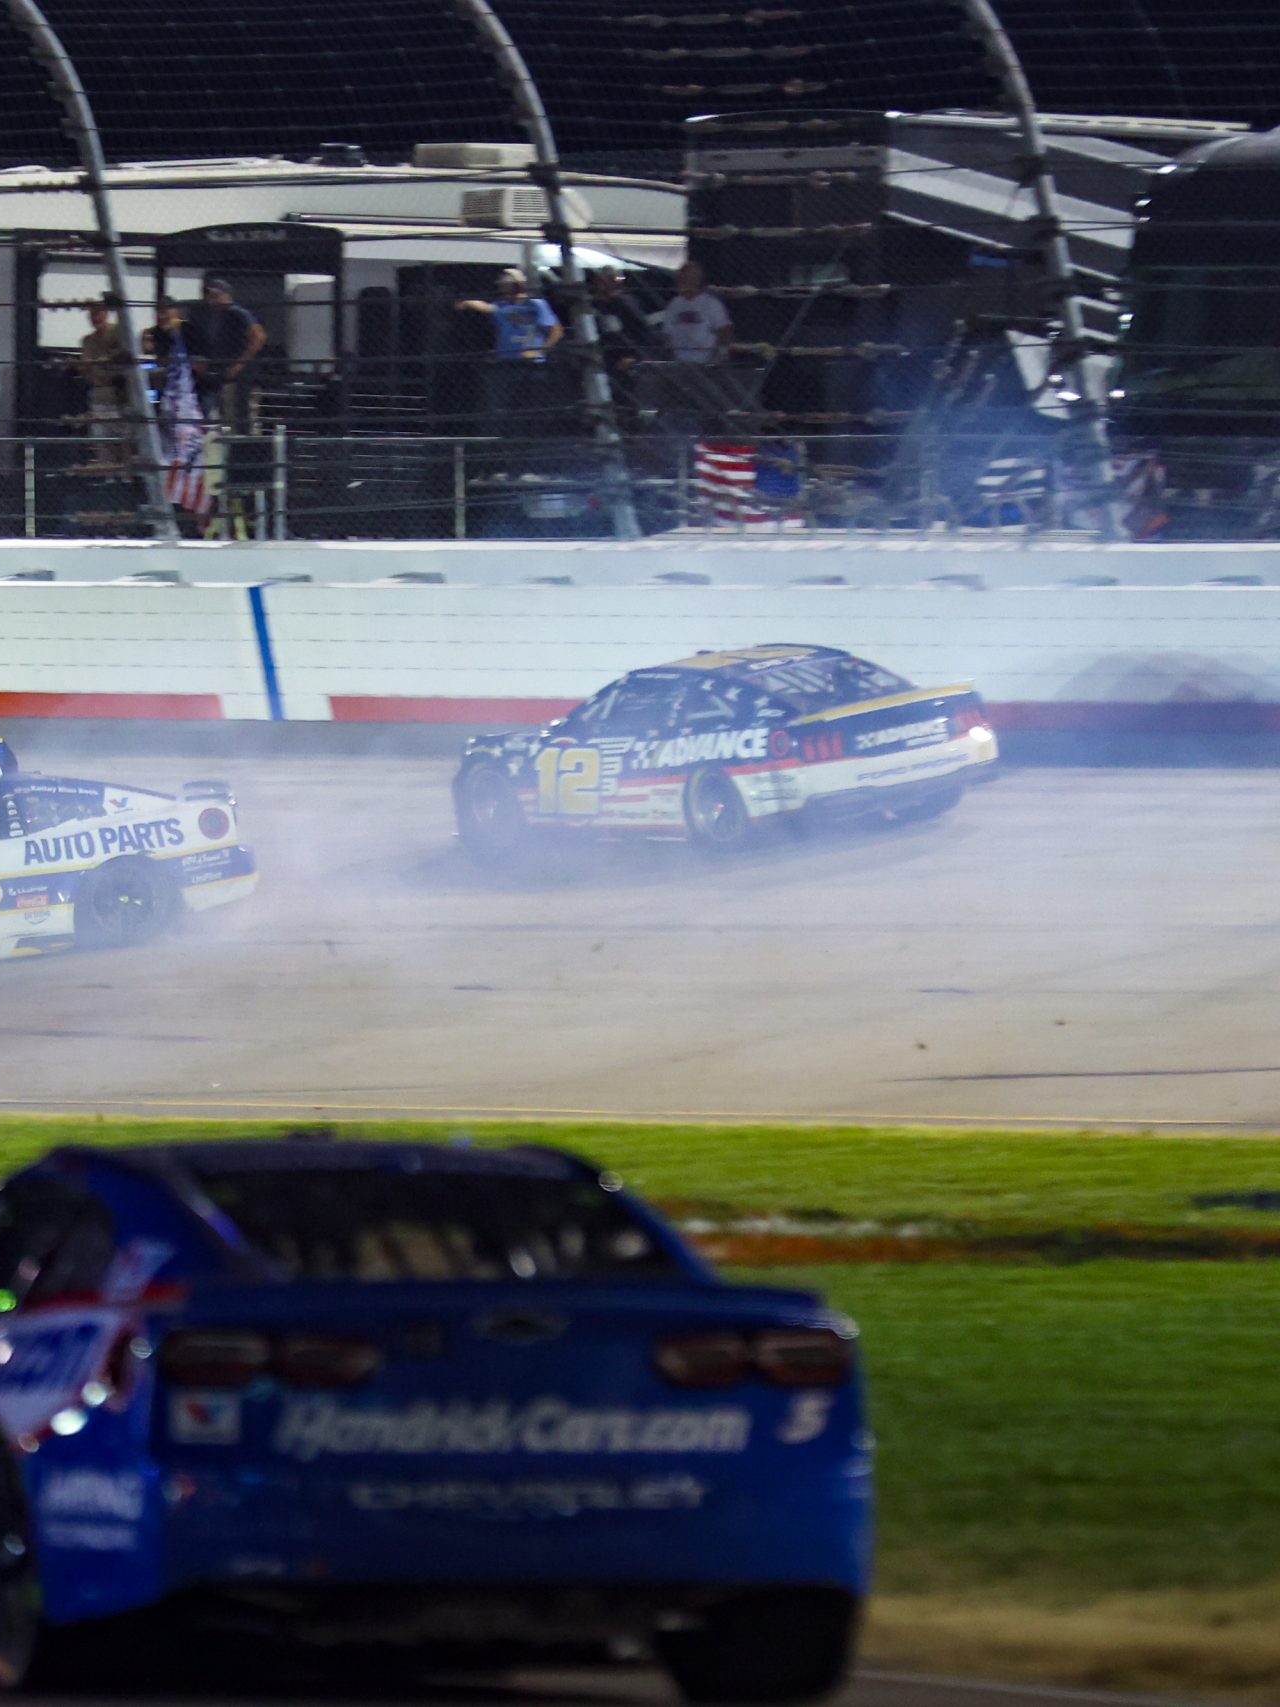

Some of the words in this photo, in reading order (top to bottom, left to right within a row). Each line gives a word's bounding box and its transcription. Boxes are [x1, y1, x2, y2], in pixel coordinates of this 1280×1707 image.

[656, 728, 769, 768] ADVANCE
[535, 747, 601, 814] 12
[23, 831, 96, 866] AUTO
[98, 818, 185, 855] PARTS
[272, 1396, 750, 1460] HendrickCars.com
[777, 1391, 833, 1445] 5
